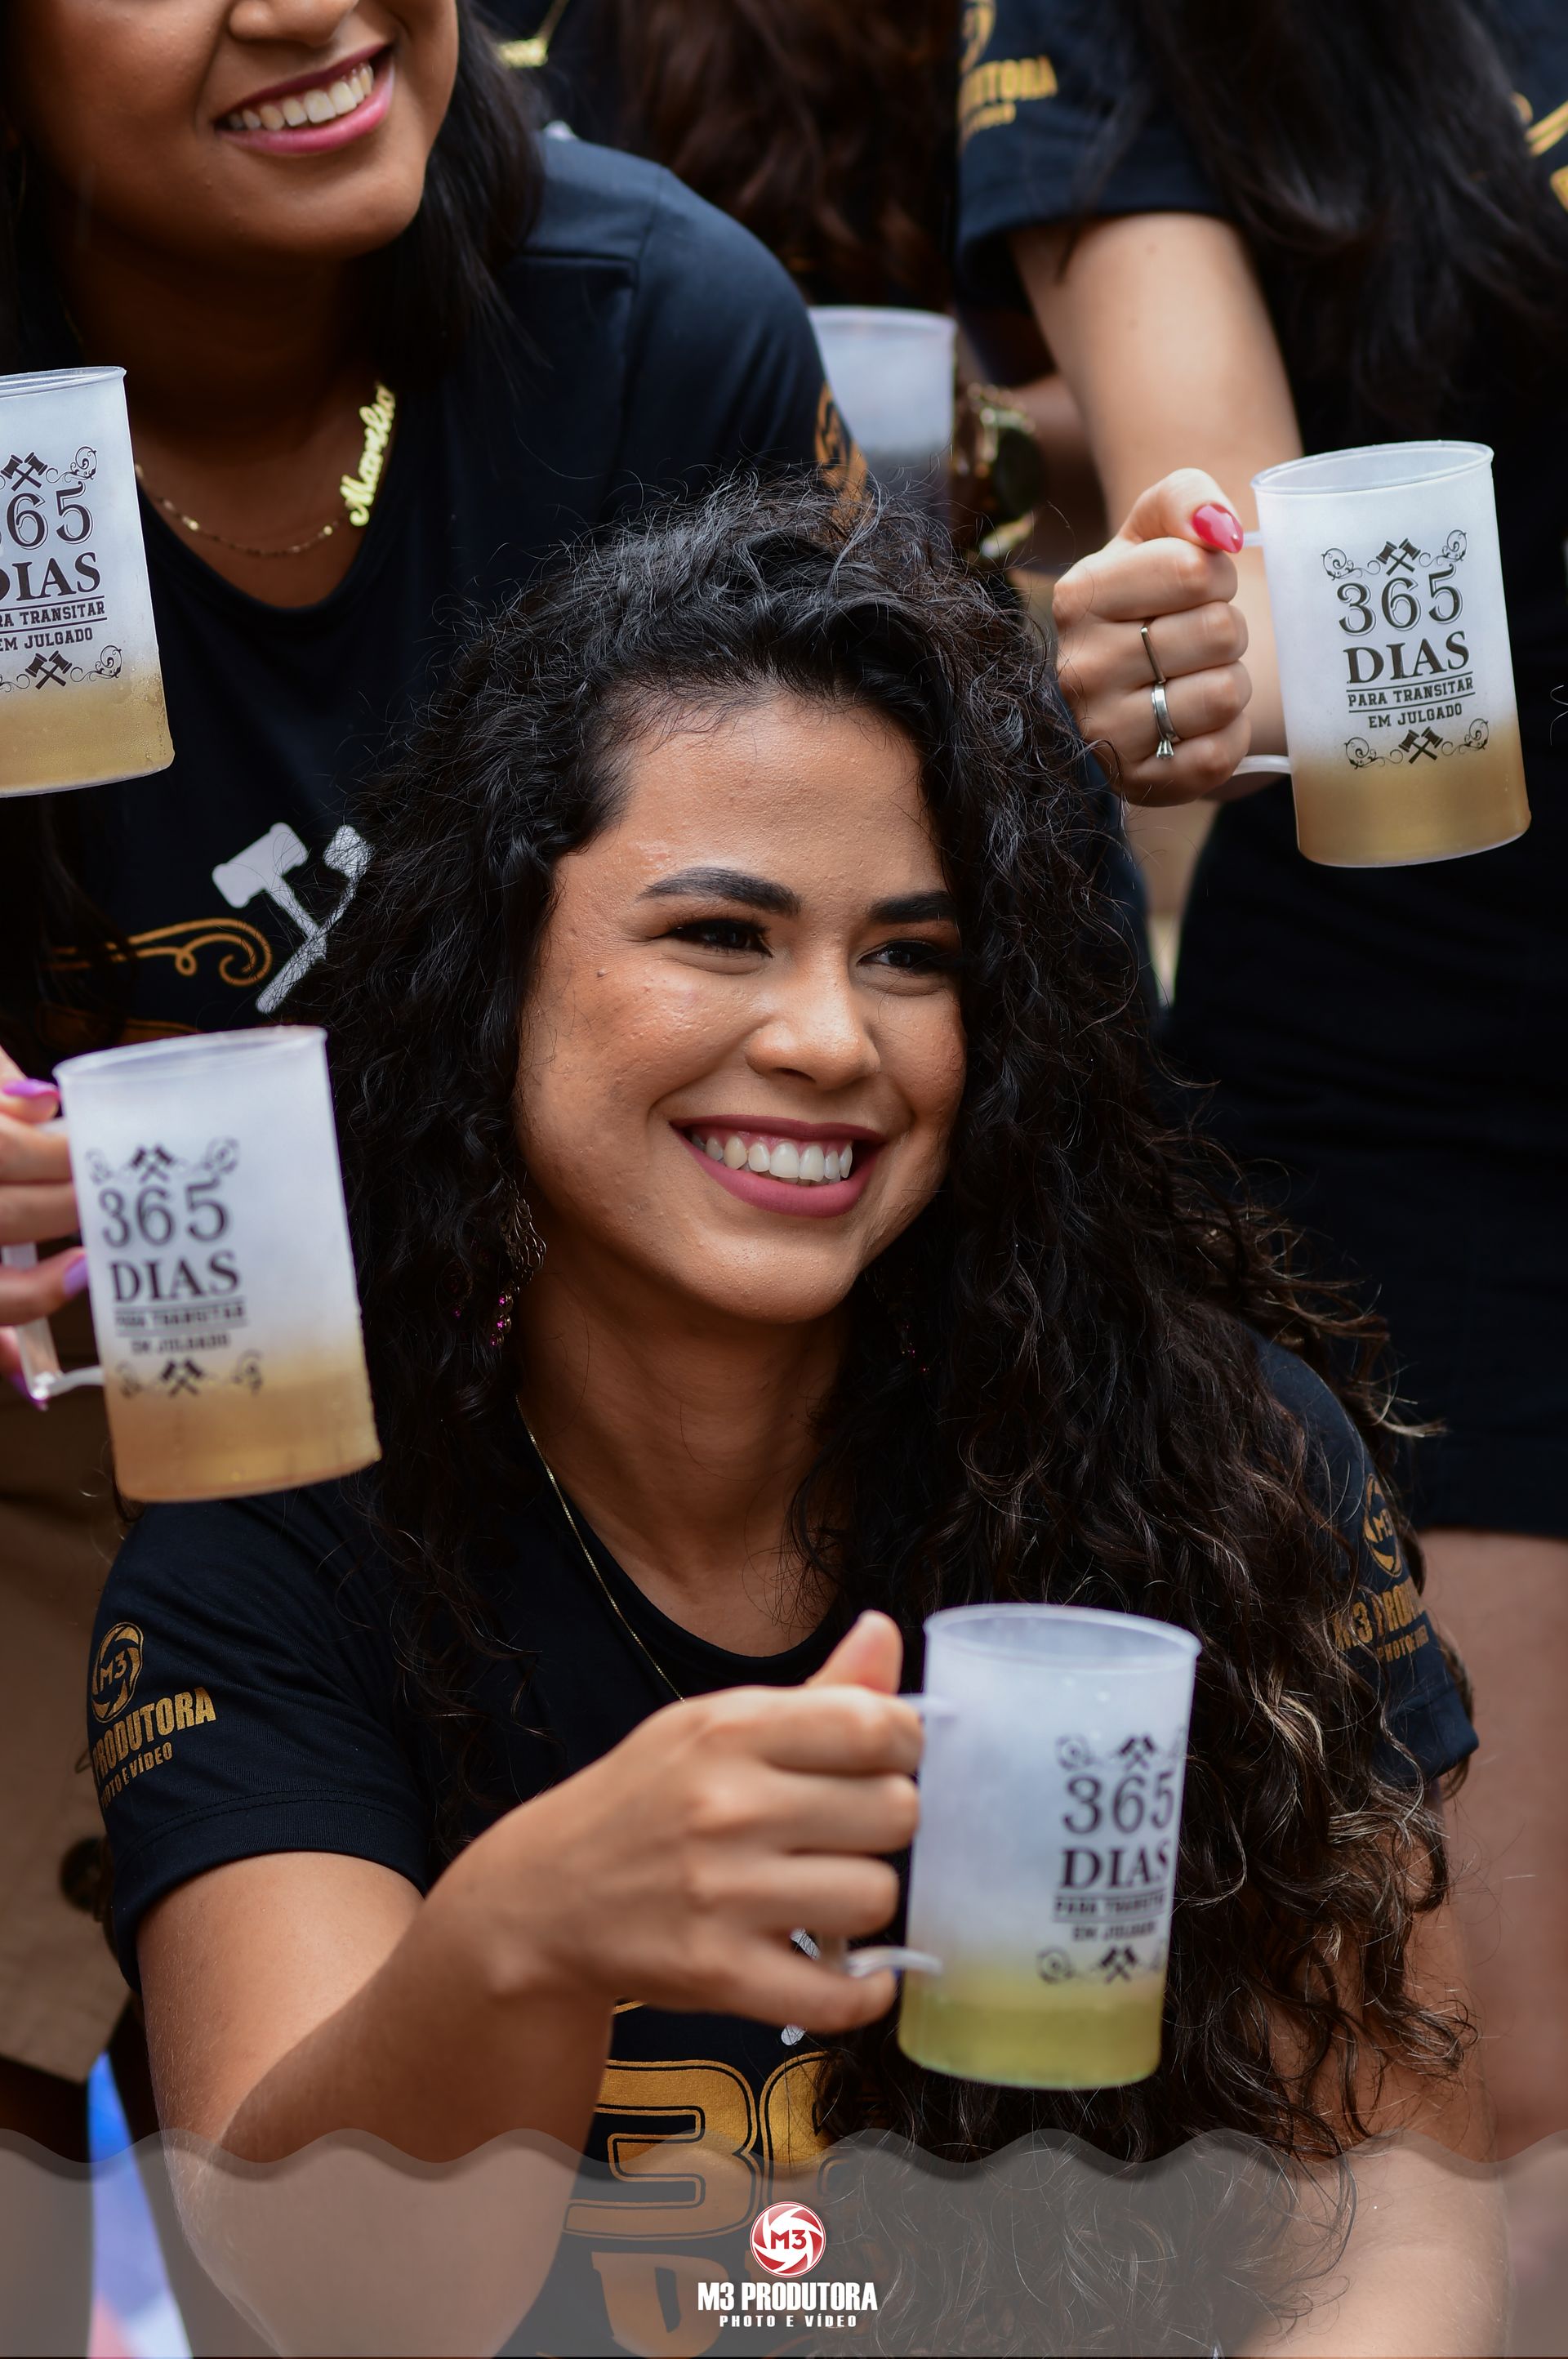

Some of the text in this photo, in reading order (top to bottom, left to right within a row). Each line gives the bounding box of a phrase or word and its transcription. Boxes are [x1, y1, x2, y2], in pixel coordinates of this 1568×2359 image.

[0, 481, 93, 551] 65
[0, 551, 100, 601] IAS
[1337, 564, 1463, 636] 365
[20, 600, 105, 625] TRANSITAR
[24, 627, 92, 649] JULGADO
[1343, 631, 1469, 684] DIAS
[1348, 676, 1473, 707] PARA TRANSITAR
[1369, 702, 1463, 728] EM JULGADO
[98, 1179, 229, 1247] 365
[109, 1250, 240, 1304] DIAS
[99, 1650, 128, 1692] M3
[1062, 1769, 1175, 1835] 365
[1061, 1838, 1169, 1889] DIAS
